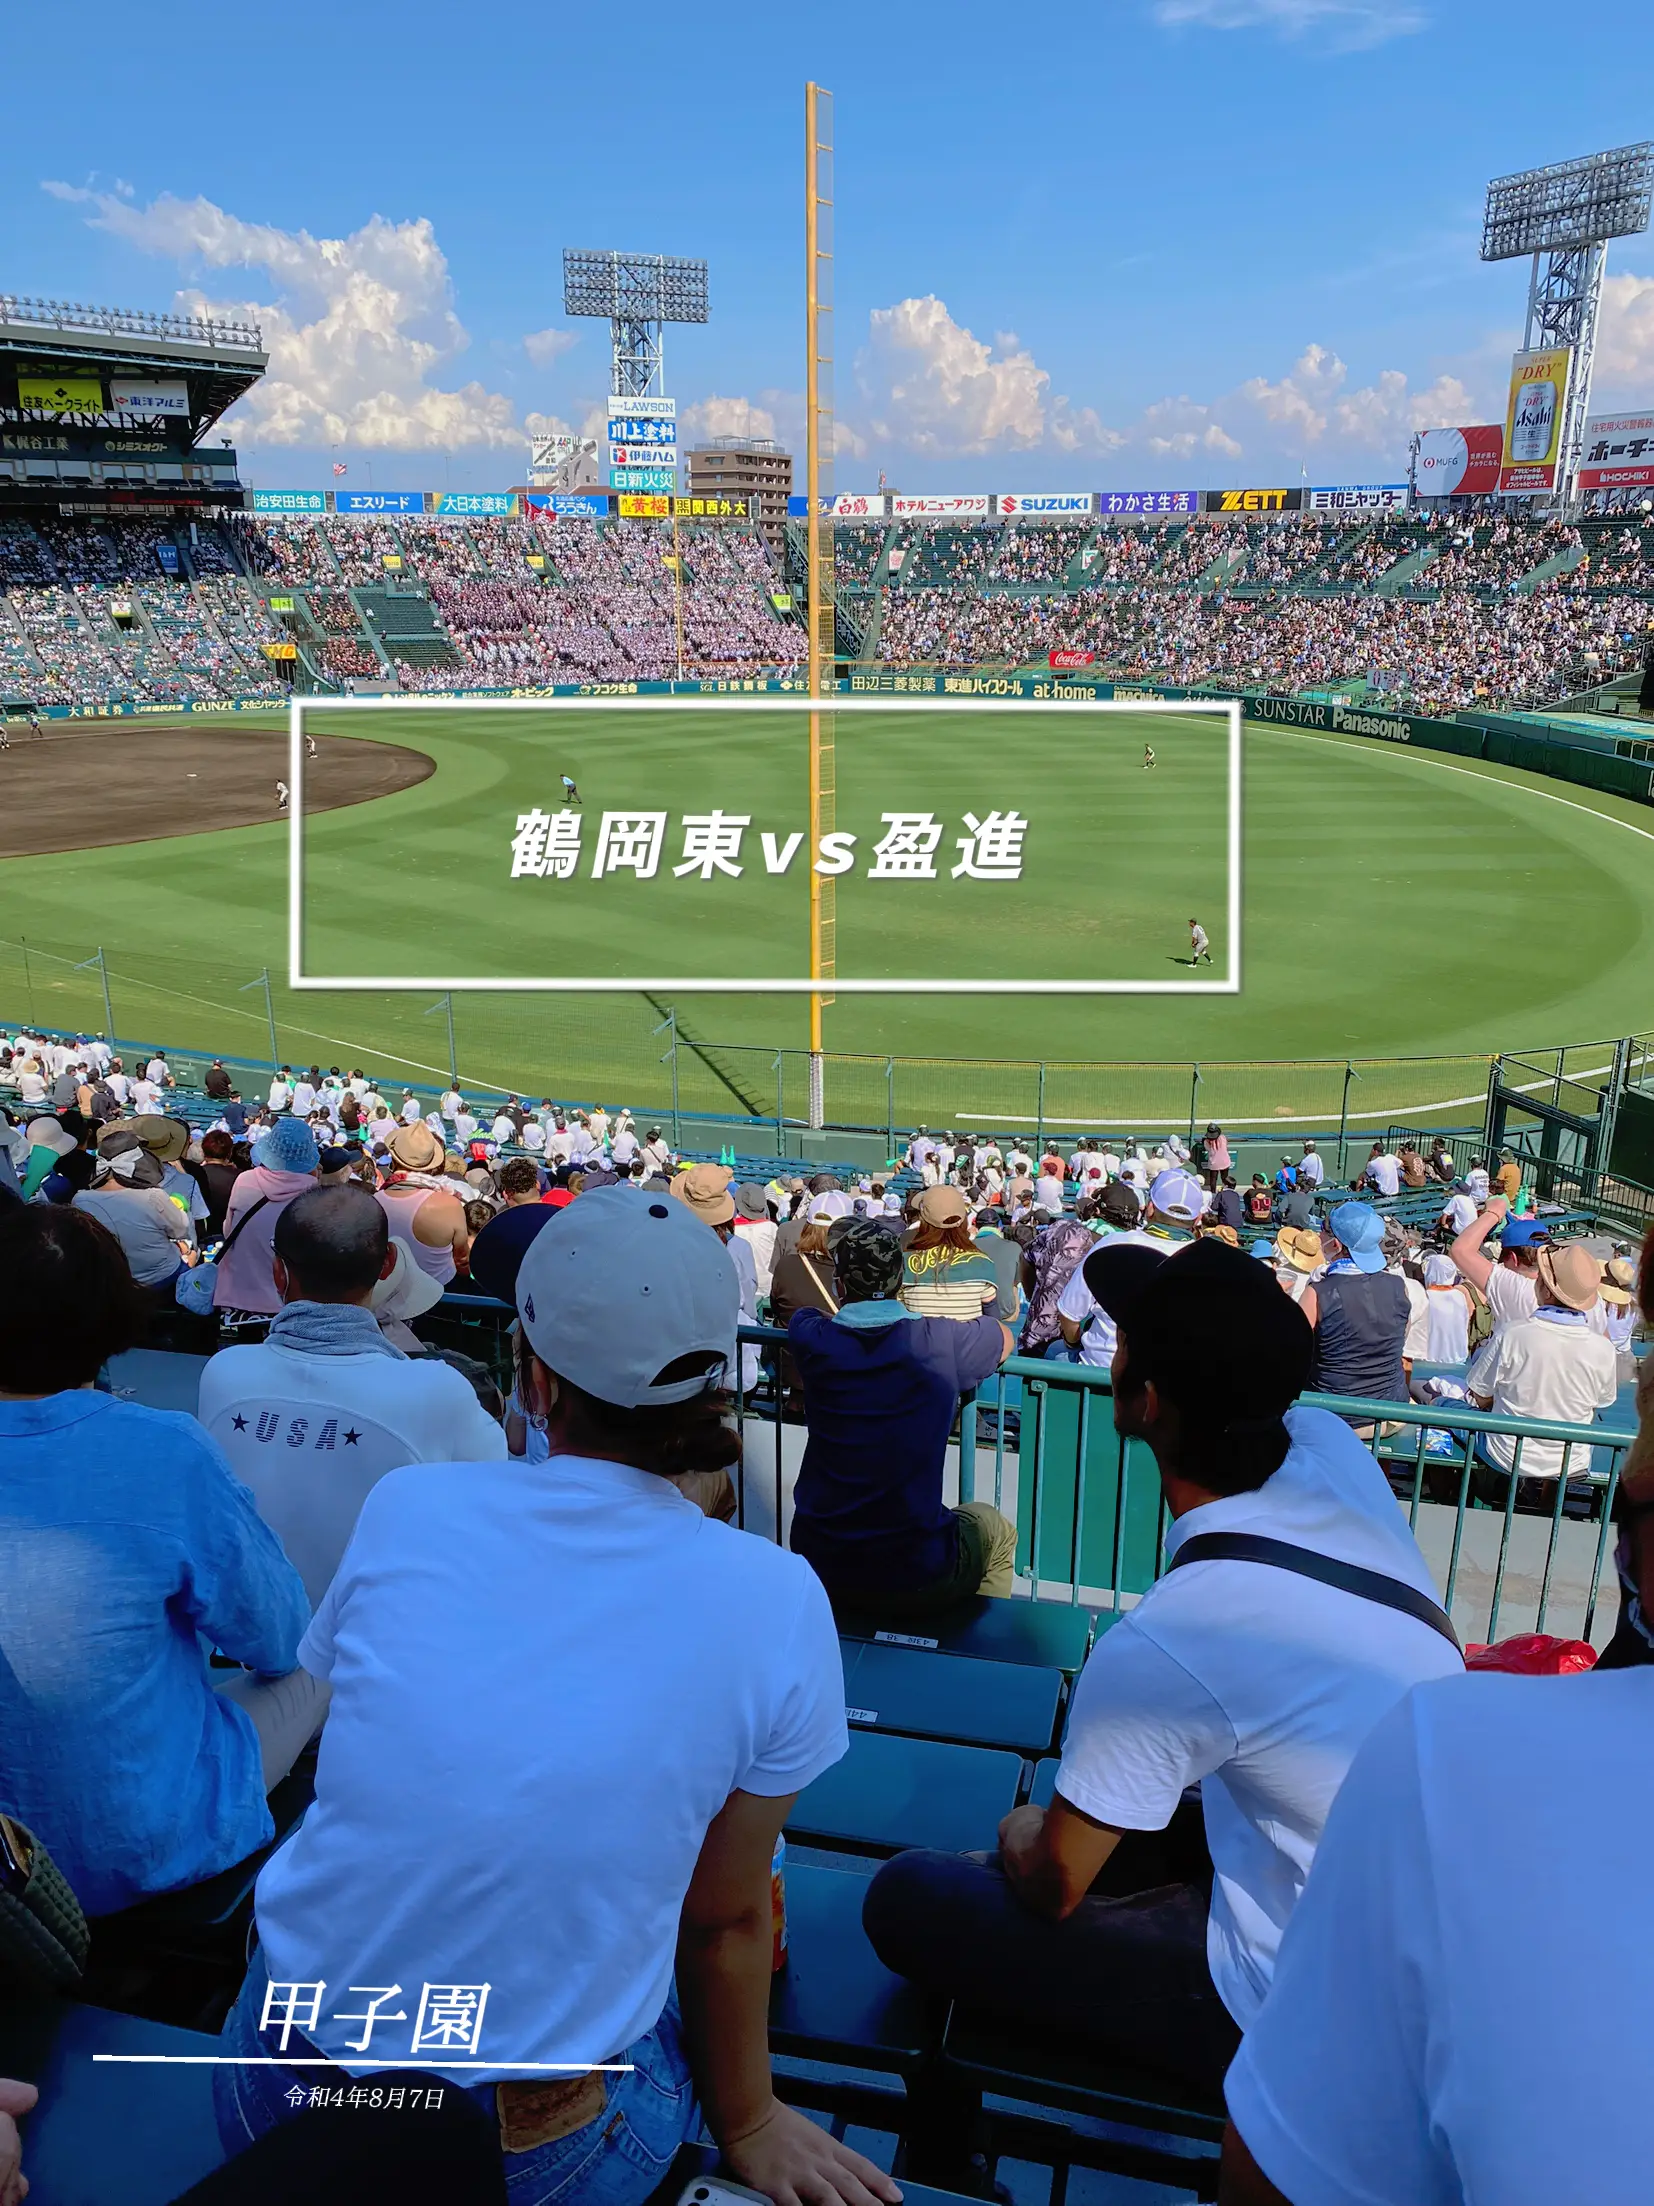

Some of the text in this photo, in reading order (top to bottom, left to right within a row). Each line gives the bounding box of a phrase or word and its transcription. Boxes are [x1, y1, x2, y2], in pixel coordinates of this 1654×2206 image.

[23, 395, 101, 412] 住友ベークライト
[130, 396, 185, 408] 東洋アルミ
[624, 401, 673, 412] LAWSON
[1516, 406, 1552, 427] Asahi
[611, 421, 675, 441] 川上塗料
[1592, 418, 1654, 433] 住宅用火災警報器
[629, 450, 675, 462] 伊藤ハム
[1436, 457, 1458, 466] MUFG
[614, 471, 674, 488] 日新火災
[254, 494, 322, 509] 治安田生命
[350, 496, 410, 510] エスリード
[443, 496, 508, 512] 大日本塗料
[631, 496, 669, 515] 黄桜
[692, 499, 747, 516] 関西外大
[838, 497, 869, 515] 白鶴
[895, 498, 986, 512] ホテルニューアワジ
[1020, 497, 1089, 511] SUZUKI
[1108, 492, 1190, 512] わかさ生活
[1220, 490, 1288, 511] ZETT
[1315, 490, 1402, 508] 三和シャッター
[555, 502, 597, 515] ろうきん
[592, 682, 638, 695] フコク生命
[717, 680, 768, 691] 日鉄鋼板
[851, 675, 936, 692] 田辺三菱製薬
[944, 678, 1024, 696] 東進ハイスクール
[1033, 681, 1097, 701] at home
[68, 704, 124, 718] 大和証券
[191, 700, 236, 712] GUNZE
[1254, 698, 1326, 726] SUNSTAR
[1332, 706, 1412, 741] Panasonic
[255, 1411, 339, 1450] USA
